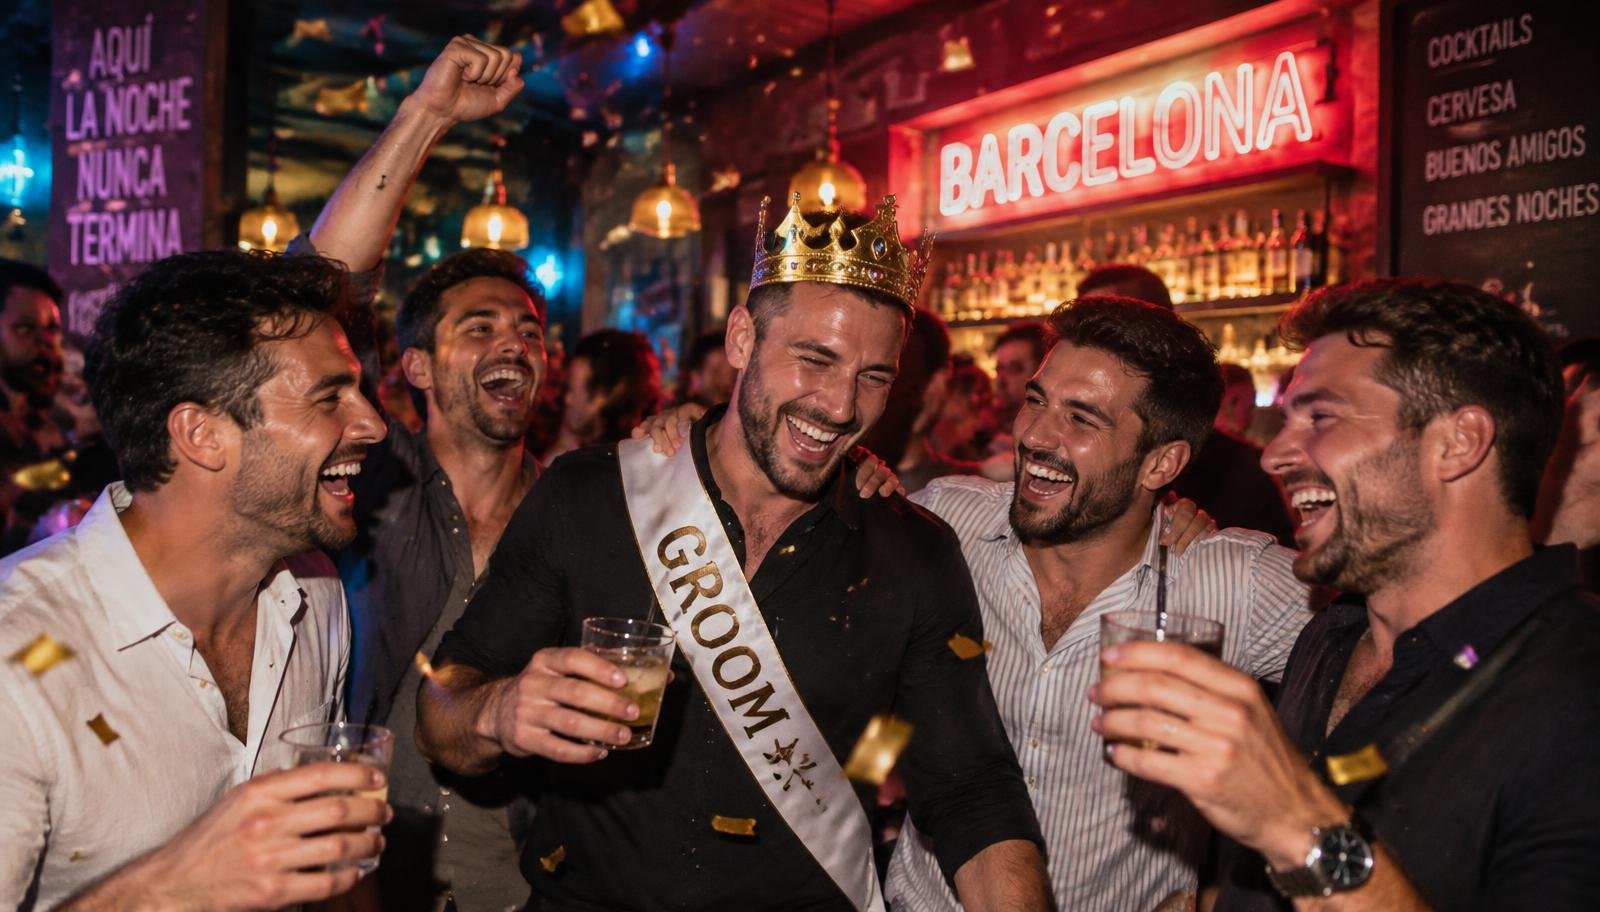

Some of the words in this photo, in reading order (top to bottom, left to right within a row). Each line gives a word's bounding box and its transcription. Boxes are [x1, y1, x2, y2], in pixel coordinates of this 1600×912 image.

[89, 13, 153, 81] AQUÍ
[1428, 14, 1533, 67] COCKTAILS
[66, 90, 98, 141] LA
[106, 77, 192, 136] NOCHE
[1427, 79, 1517, 127] CERVESA
[940, 51, 1312, 216] BARCELONA
[1425, 140, 1502, 183] BUENOS
[1507, 124, 1586, 168] AMIGOS
[77, 145, 167, 200] NUNCA
[66, 208, 183, 266] TERMINA
[1423, 194, 1510, 236] GRANDES
[1517, 183, 1599, 224] NOCHES
[657, 525, 791, 739] GROOM
